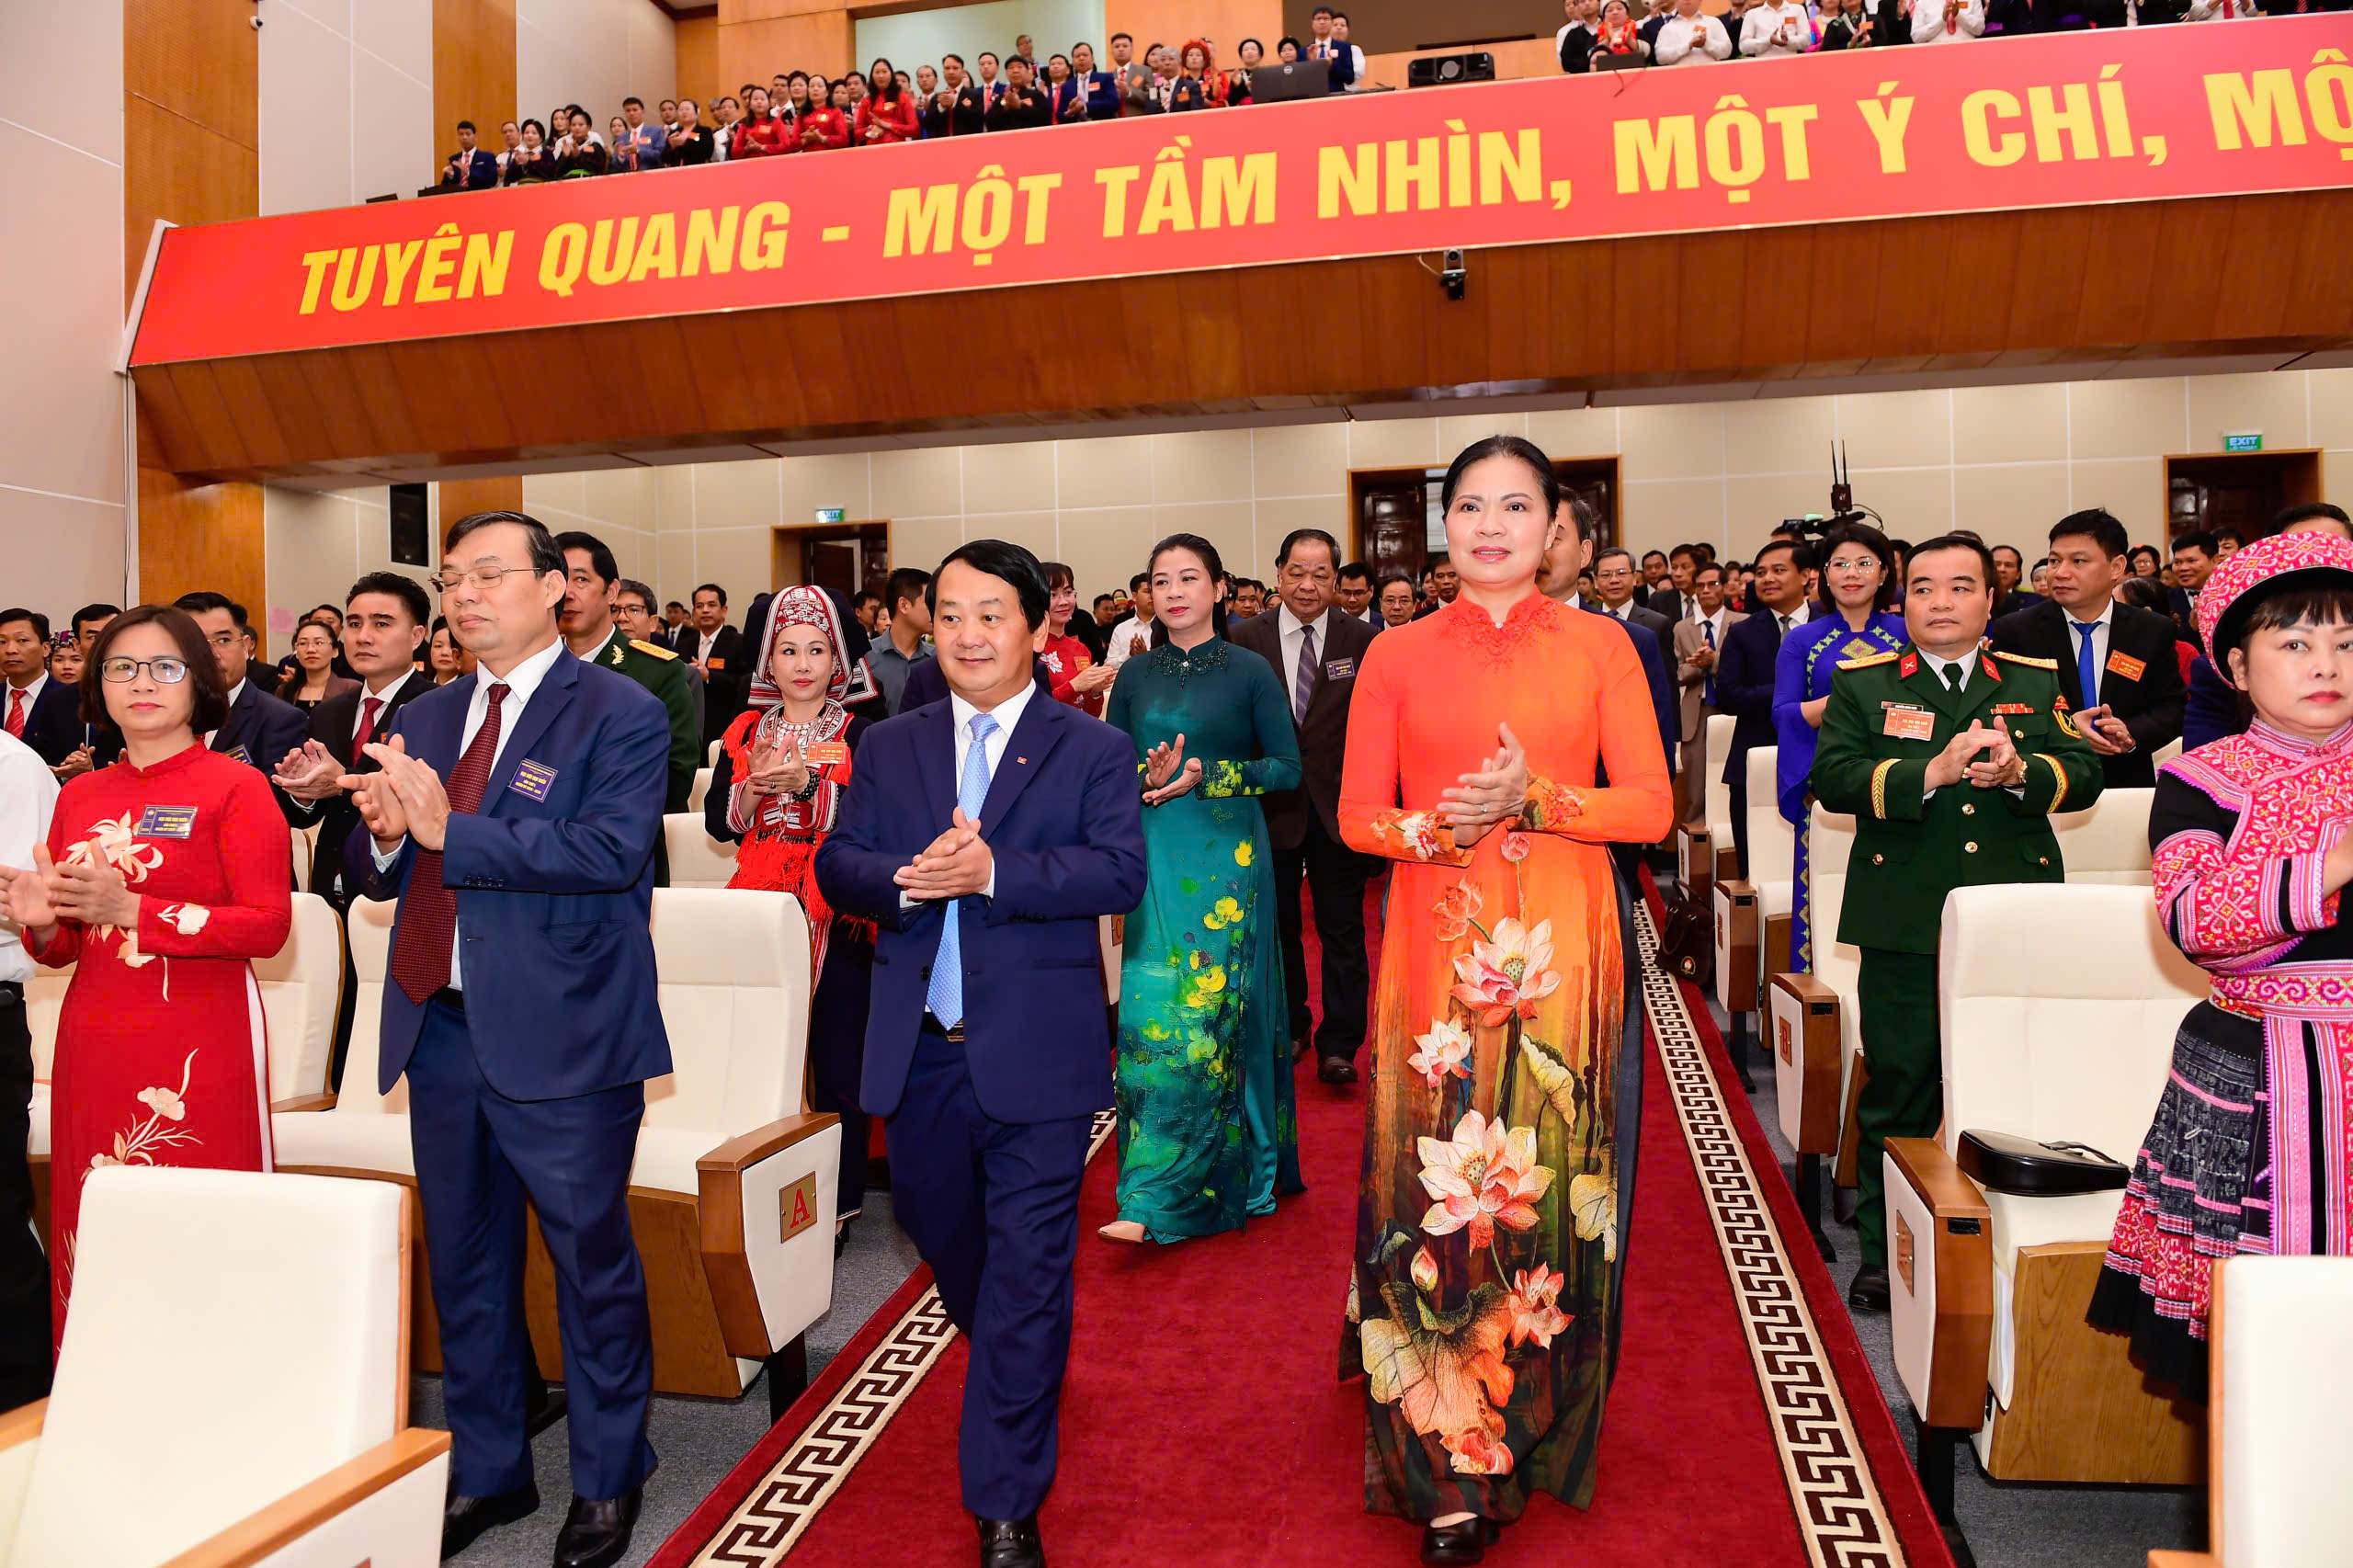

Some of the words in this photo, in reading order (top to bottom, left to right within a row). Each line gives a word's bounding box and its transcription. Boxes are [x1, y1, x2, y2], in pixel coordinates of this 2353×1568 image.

[299, 222, 516, 314] TUYÊN
[539, 200, 790, 297] QUANG
[822, 225, 850, 242] -
[882, 164, 1063, 267] MỘT
[1094, 134, 1278, 238] TẦM
[1317, 119, 1572, 219] NHÌN,
[1613, 94, 1818, 204] MỘT
[1856, 80, 1915, 174] Ý
[1961, 62, 2168, 167] CHÍ,
[2229, 437, 2257, 446] EXIT
[790, 1187, 811, 1229] A
